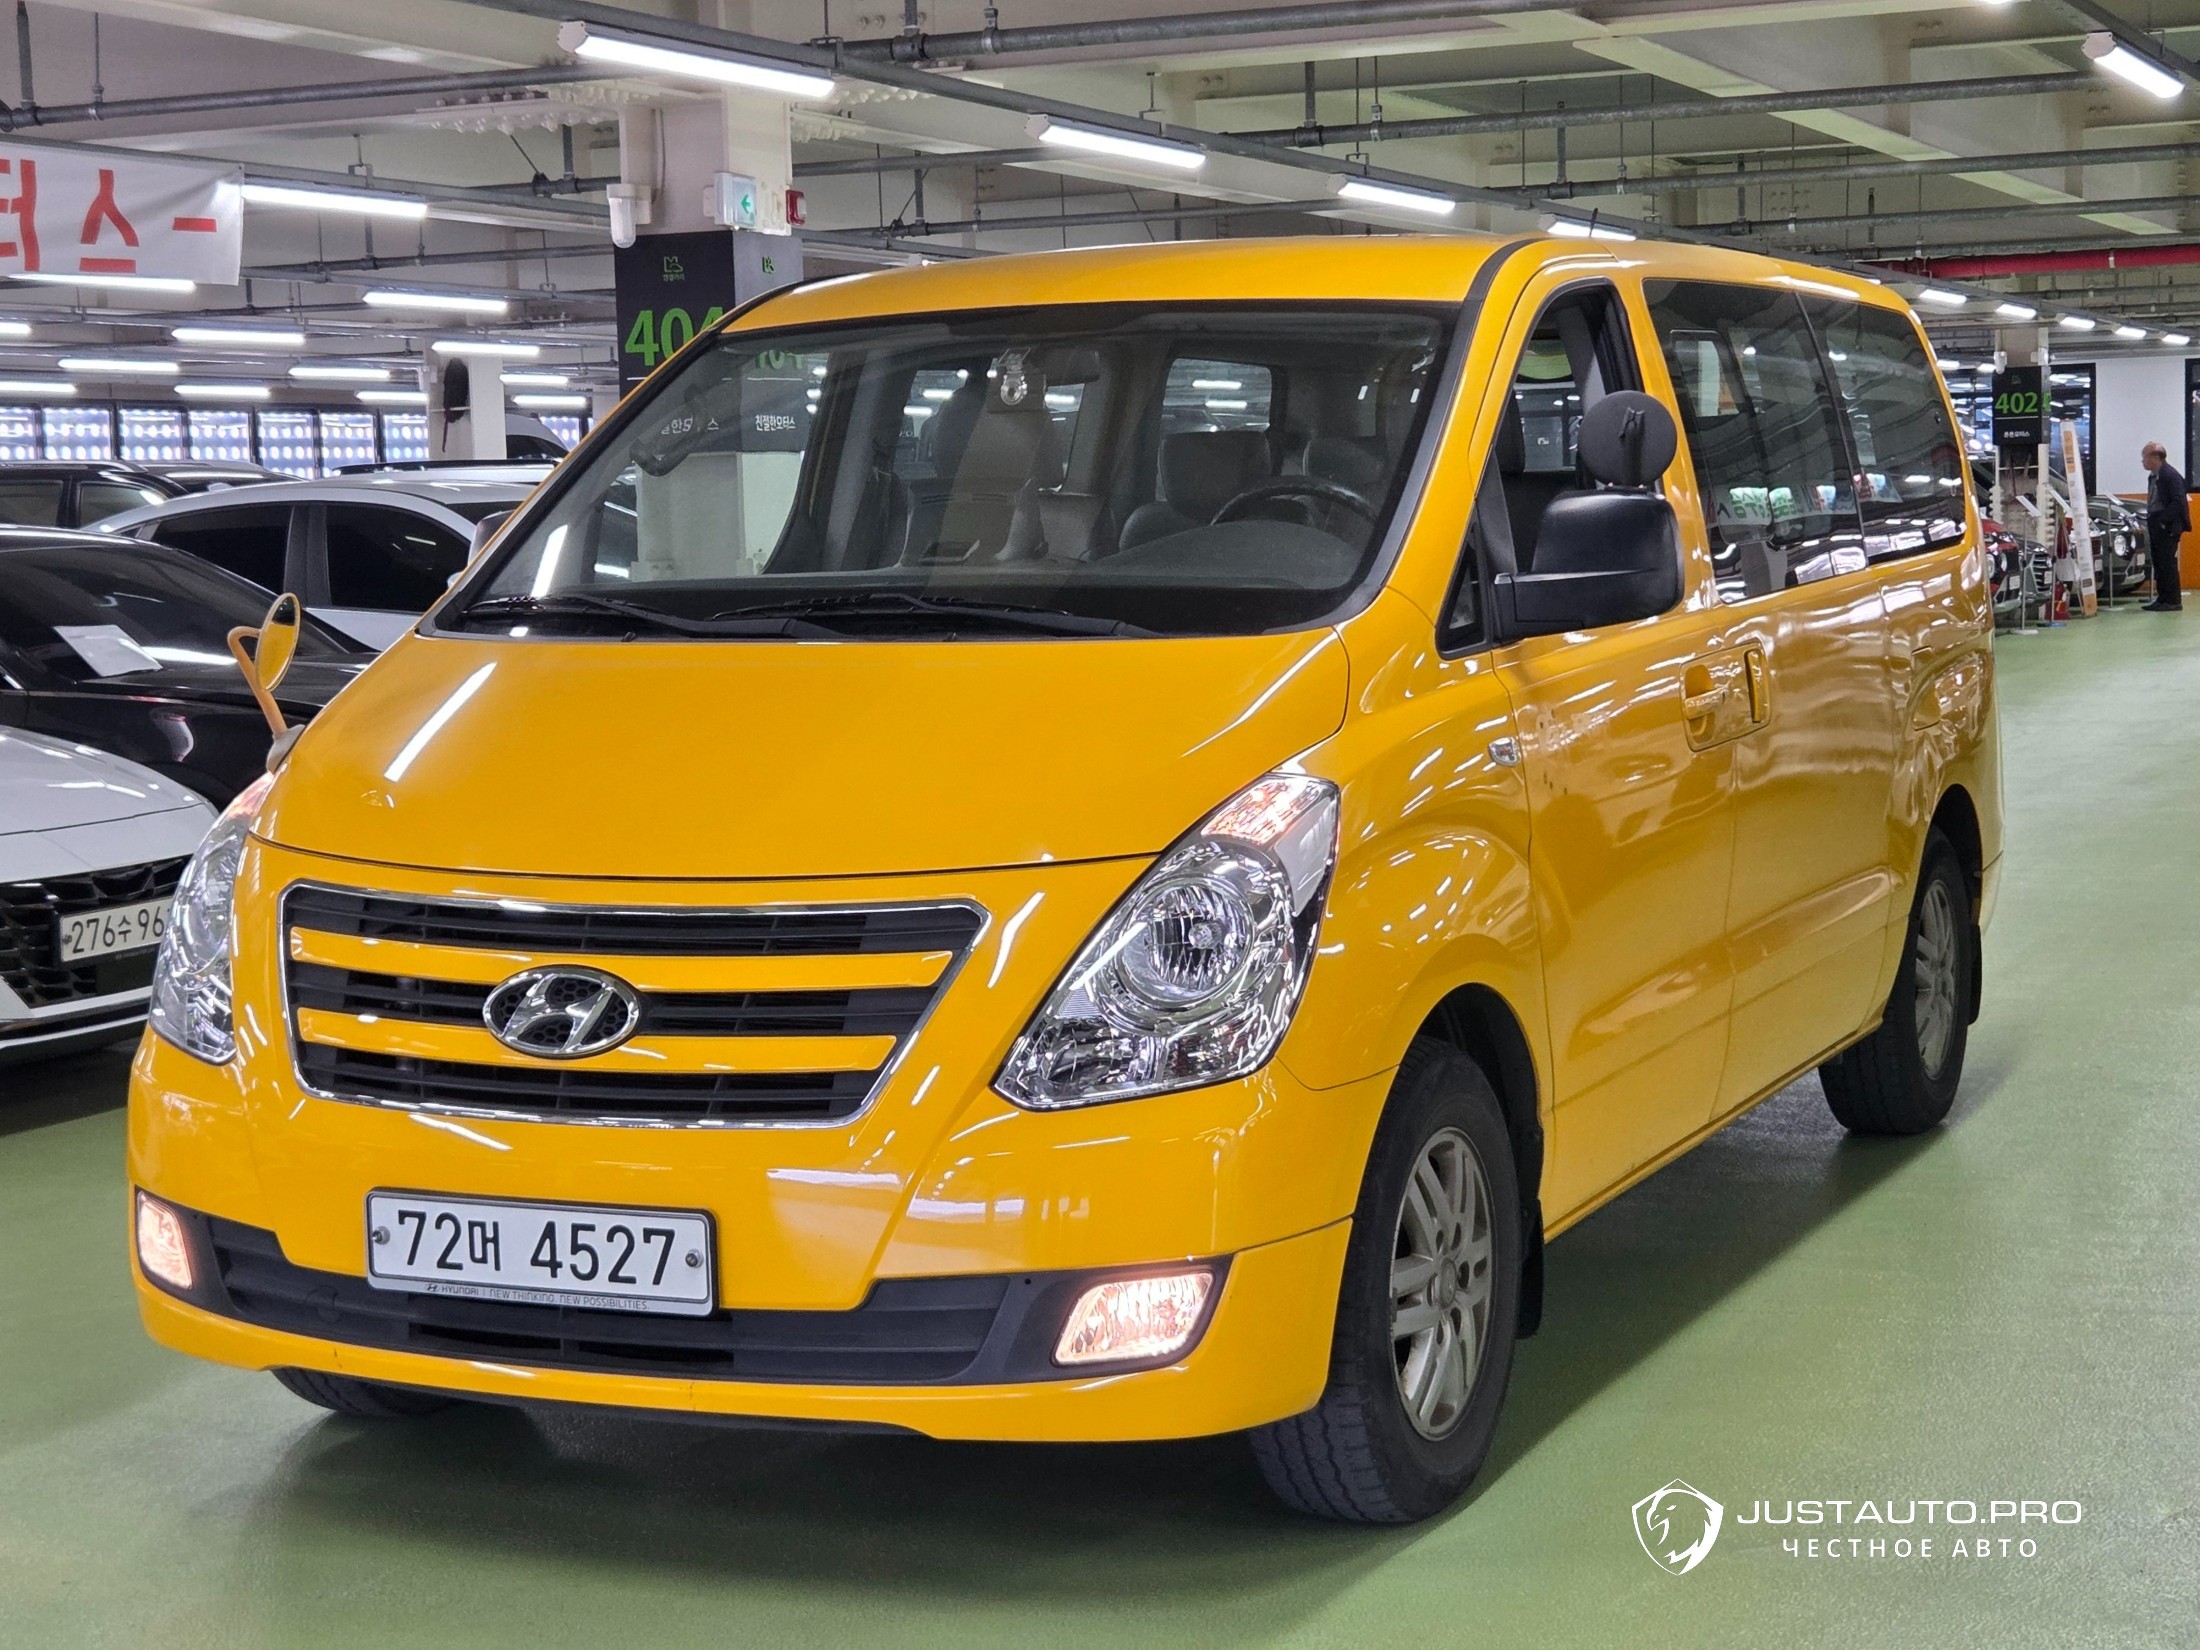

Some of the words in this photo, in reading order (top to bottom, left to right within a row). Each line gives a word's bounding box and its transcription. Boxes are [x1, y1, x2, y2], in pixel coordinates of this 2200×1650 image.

[1995, 391, 2038, 414] 402
[398, 1209, 501, 1272] 72머
[530, 1220, 676, 1286] 4527
[441, 1285, 480, 1296] HYUNDAI
